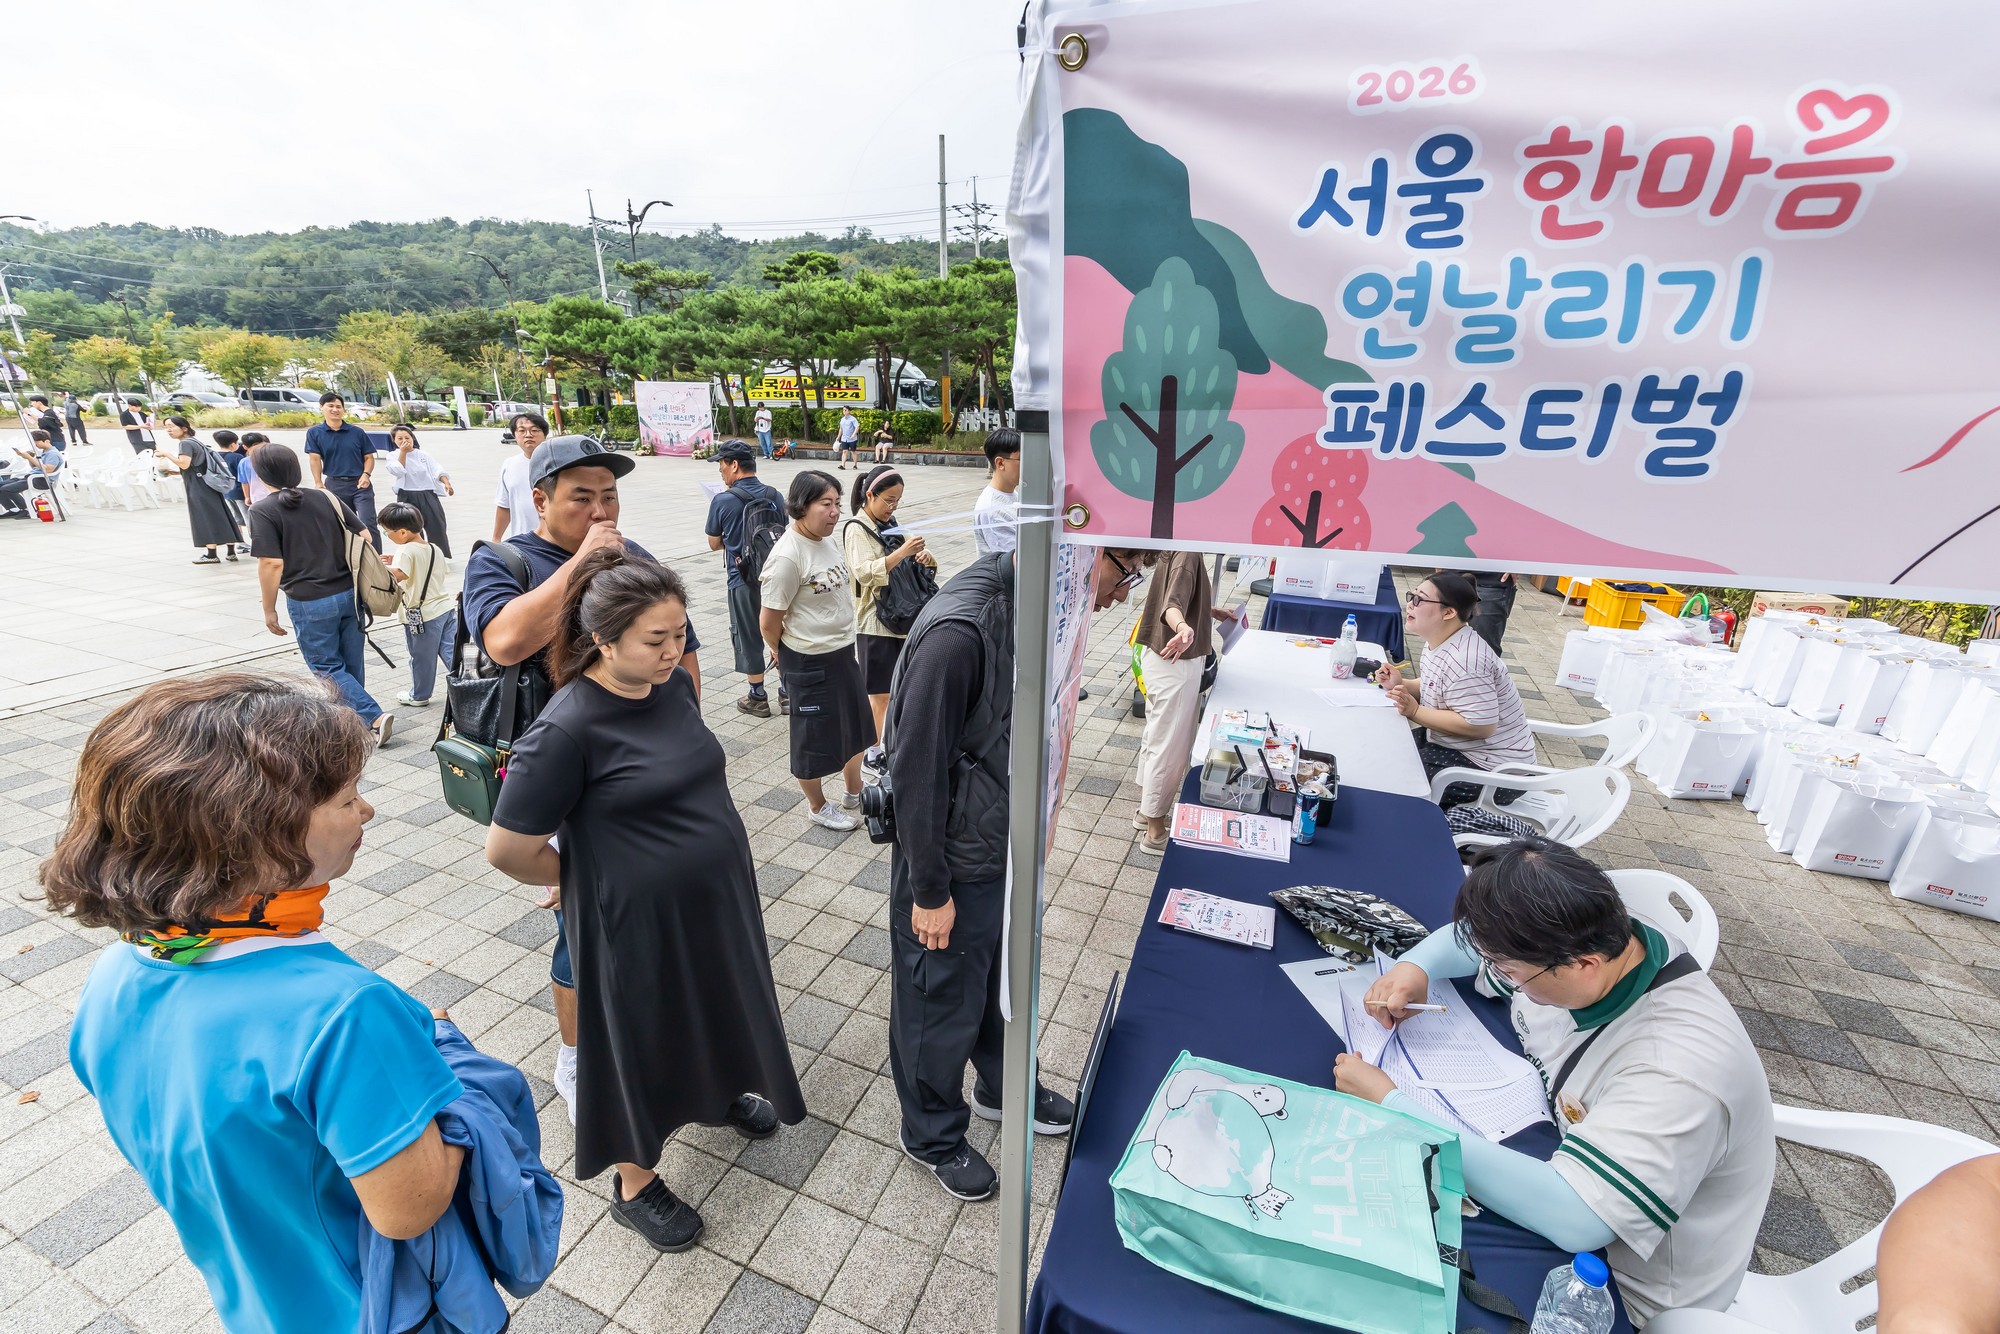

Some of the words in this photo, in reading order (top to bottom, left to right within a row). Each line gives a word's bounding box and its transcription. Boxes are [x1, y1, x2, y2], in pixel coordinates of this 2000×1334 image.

[1356, 63, 1477, 106] 2026
[1297, 133, 1484, 250] 서울
[1523, 88, 1895, 241] 한마음
[1342, 255, 1763, 365] 연날리기
[673, 413, 696, 423] 페스티벌
[763, 391, 861, 399] 158-924
[1322, 369, 1744, 479] 페스티벌
[1310, 1105, 1387, 1247] ERTH
[1360, 1149, 1397, 1229] THE
